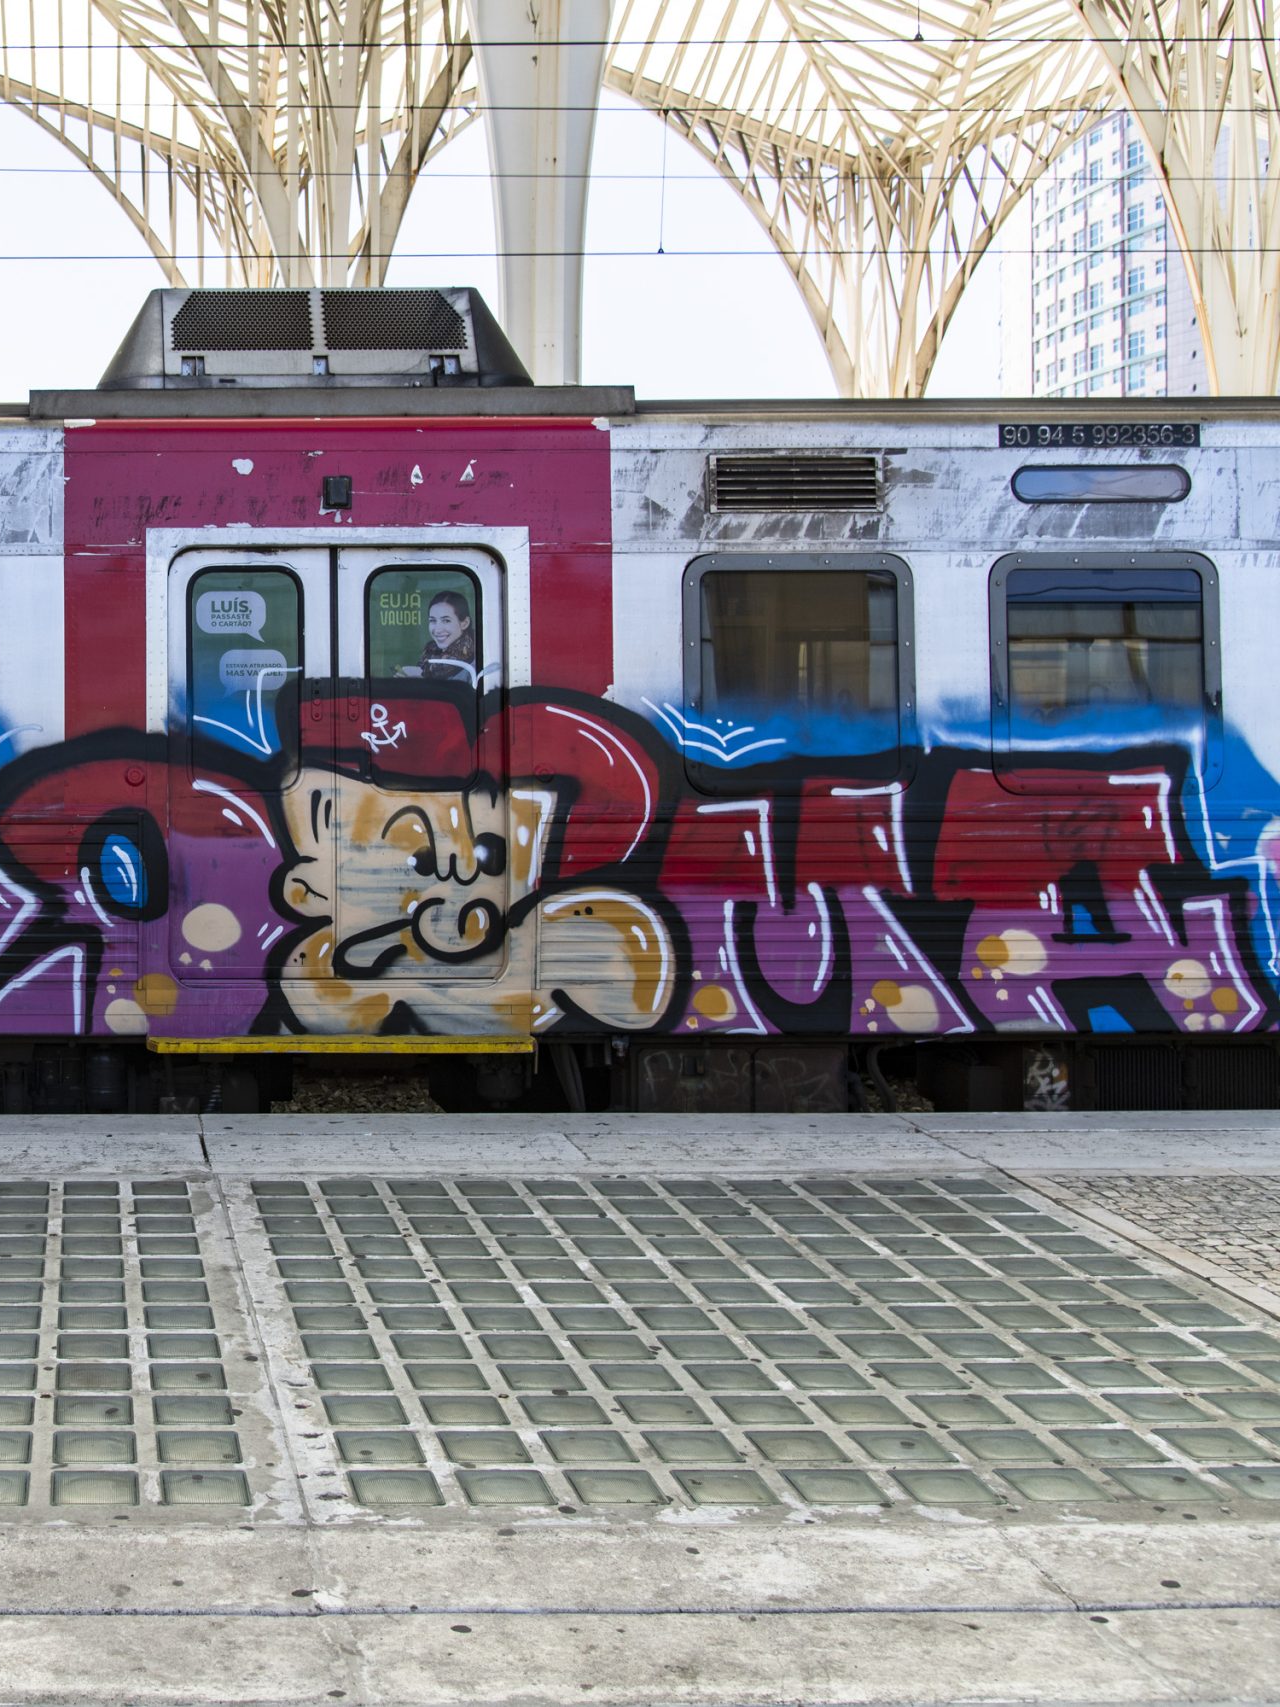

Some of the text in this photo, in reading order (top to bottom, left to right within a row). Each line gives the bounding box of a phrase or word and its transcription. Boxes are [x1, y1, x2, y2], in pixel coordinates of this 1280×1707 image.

[1002, 424, 1195, 446] 90 94 5 992356-3
[210, 597, 253, 614] LUÍS,
